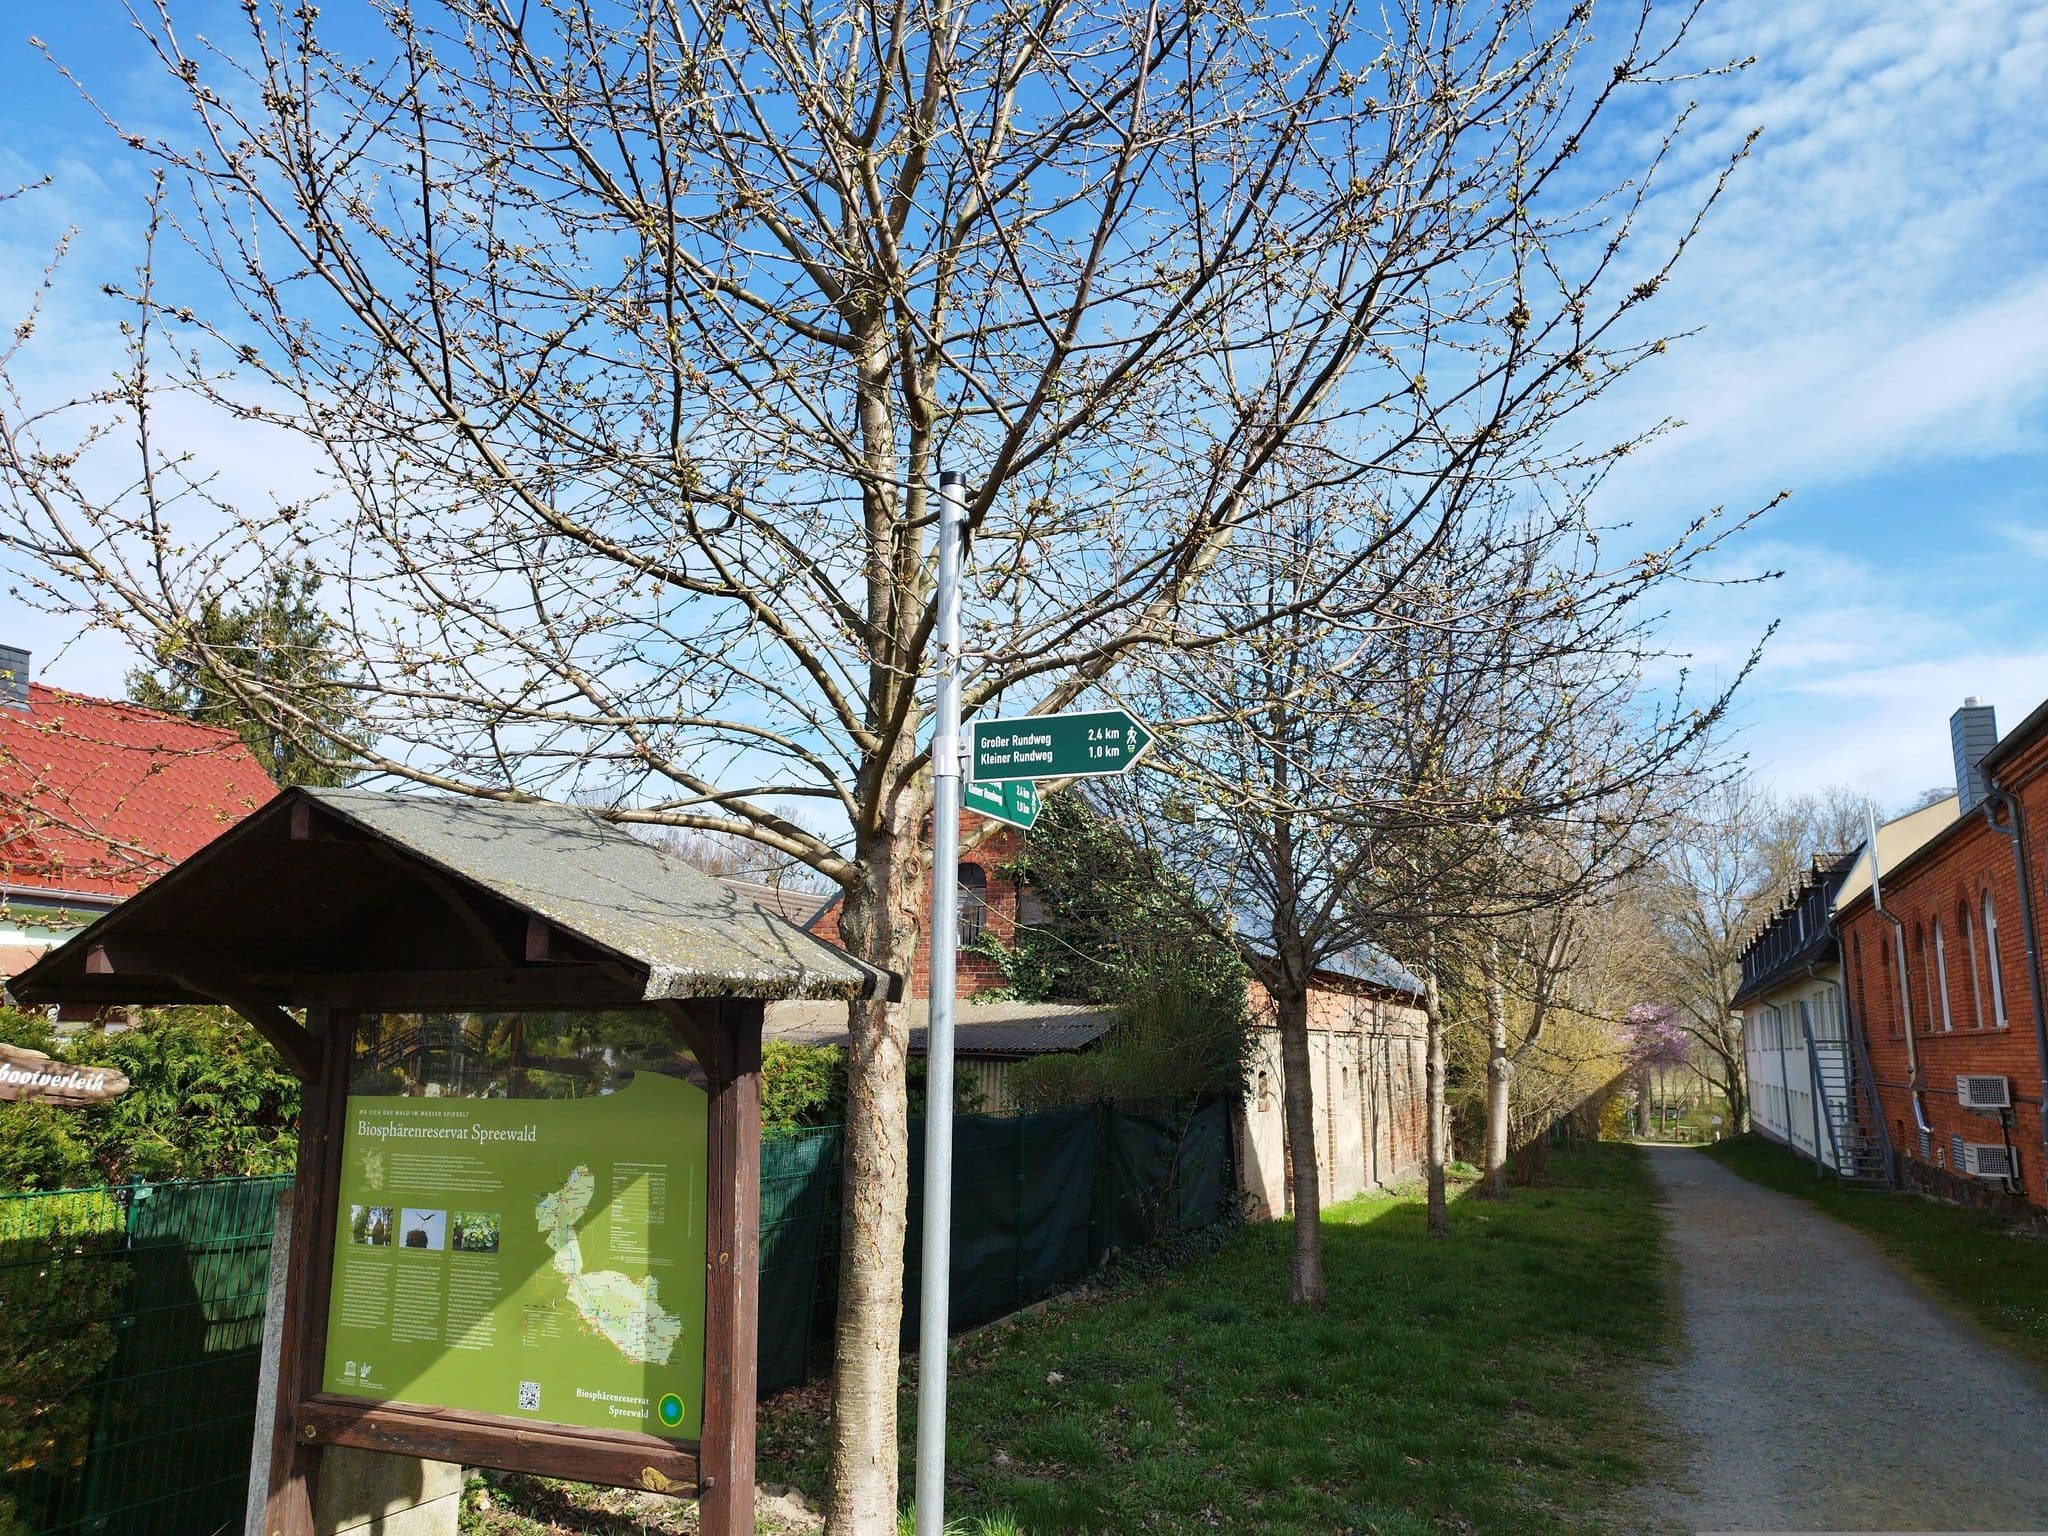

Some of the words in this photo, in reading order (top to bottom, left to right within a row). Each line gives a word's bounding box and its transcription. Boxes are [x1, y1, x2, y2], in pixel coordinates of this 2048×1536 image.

[981, 736, 1010, 749] Großer
[1012, 734, 1051, 747] Rundweg
[1088, 728, 1103, 741] 2,4
[1105, 728, 1120, 740] km
[980, 753, 1011, 765] Kleiner
[1013, 750, 1053, 763] Rundweg
[1088, 746, 1103, 759] 1,0
[1105, 746, 1120, 758] km
[358, 1120, 468, 1141] Biosphärenreservat
[471, 1123, 537, 1144] Spreewald
[576, 1387, 650, 1405] Biosphärenreservat
[608, 1405, 649, 1419] Spreewald
